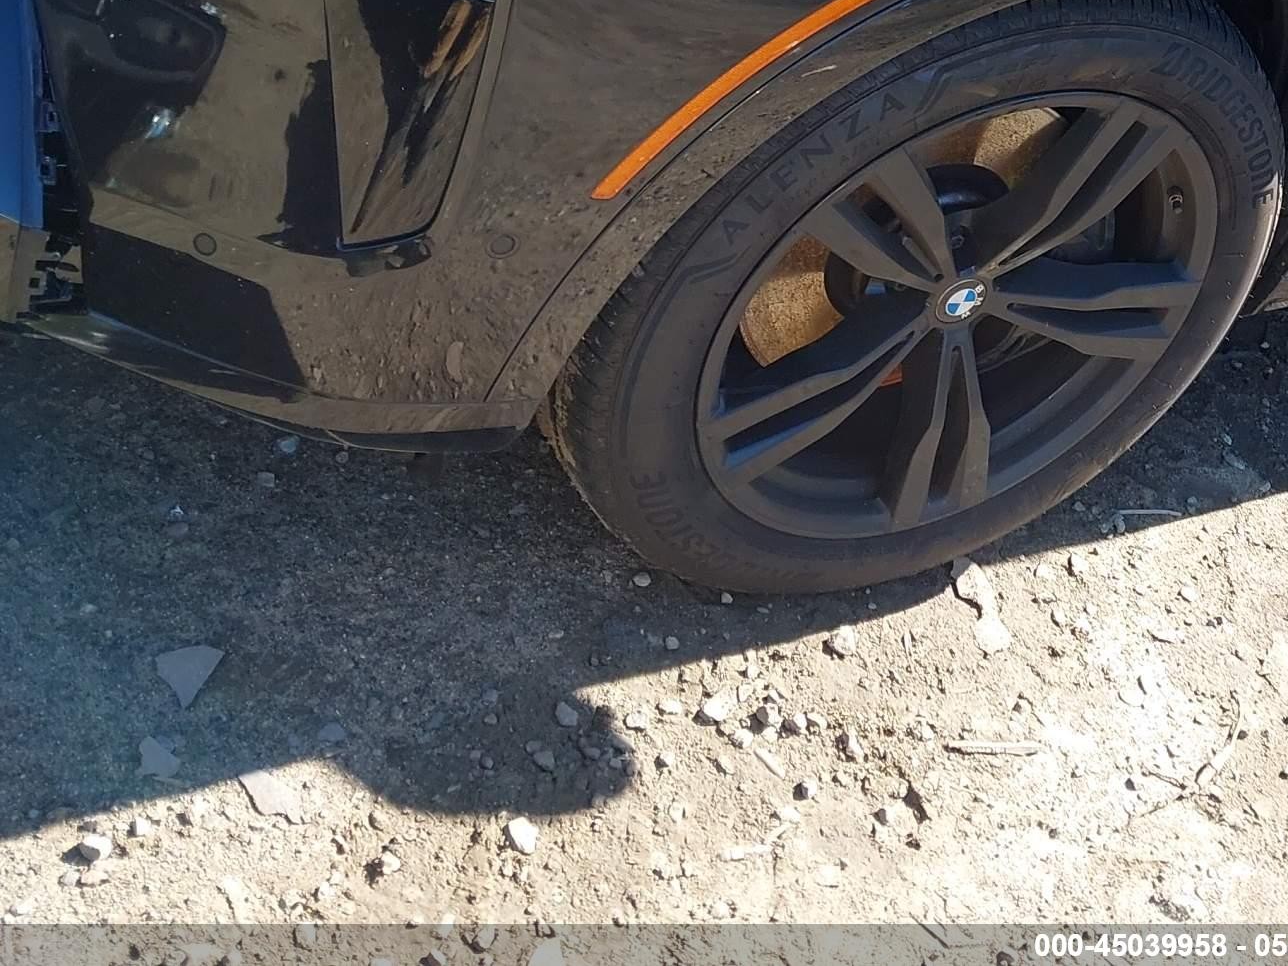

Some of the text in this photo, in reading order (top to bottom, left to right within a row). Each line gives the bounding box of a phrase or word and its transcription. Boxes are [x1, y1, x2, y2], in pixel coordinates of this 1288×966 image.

[720, 91, 906, 246] ALENZA
[1150, 40, 1275, 210] BRIDGESTONE
[960, 283, 985, 321] BMW
